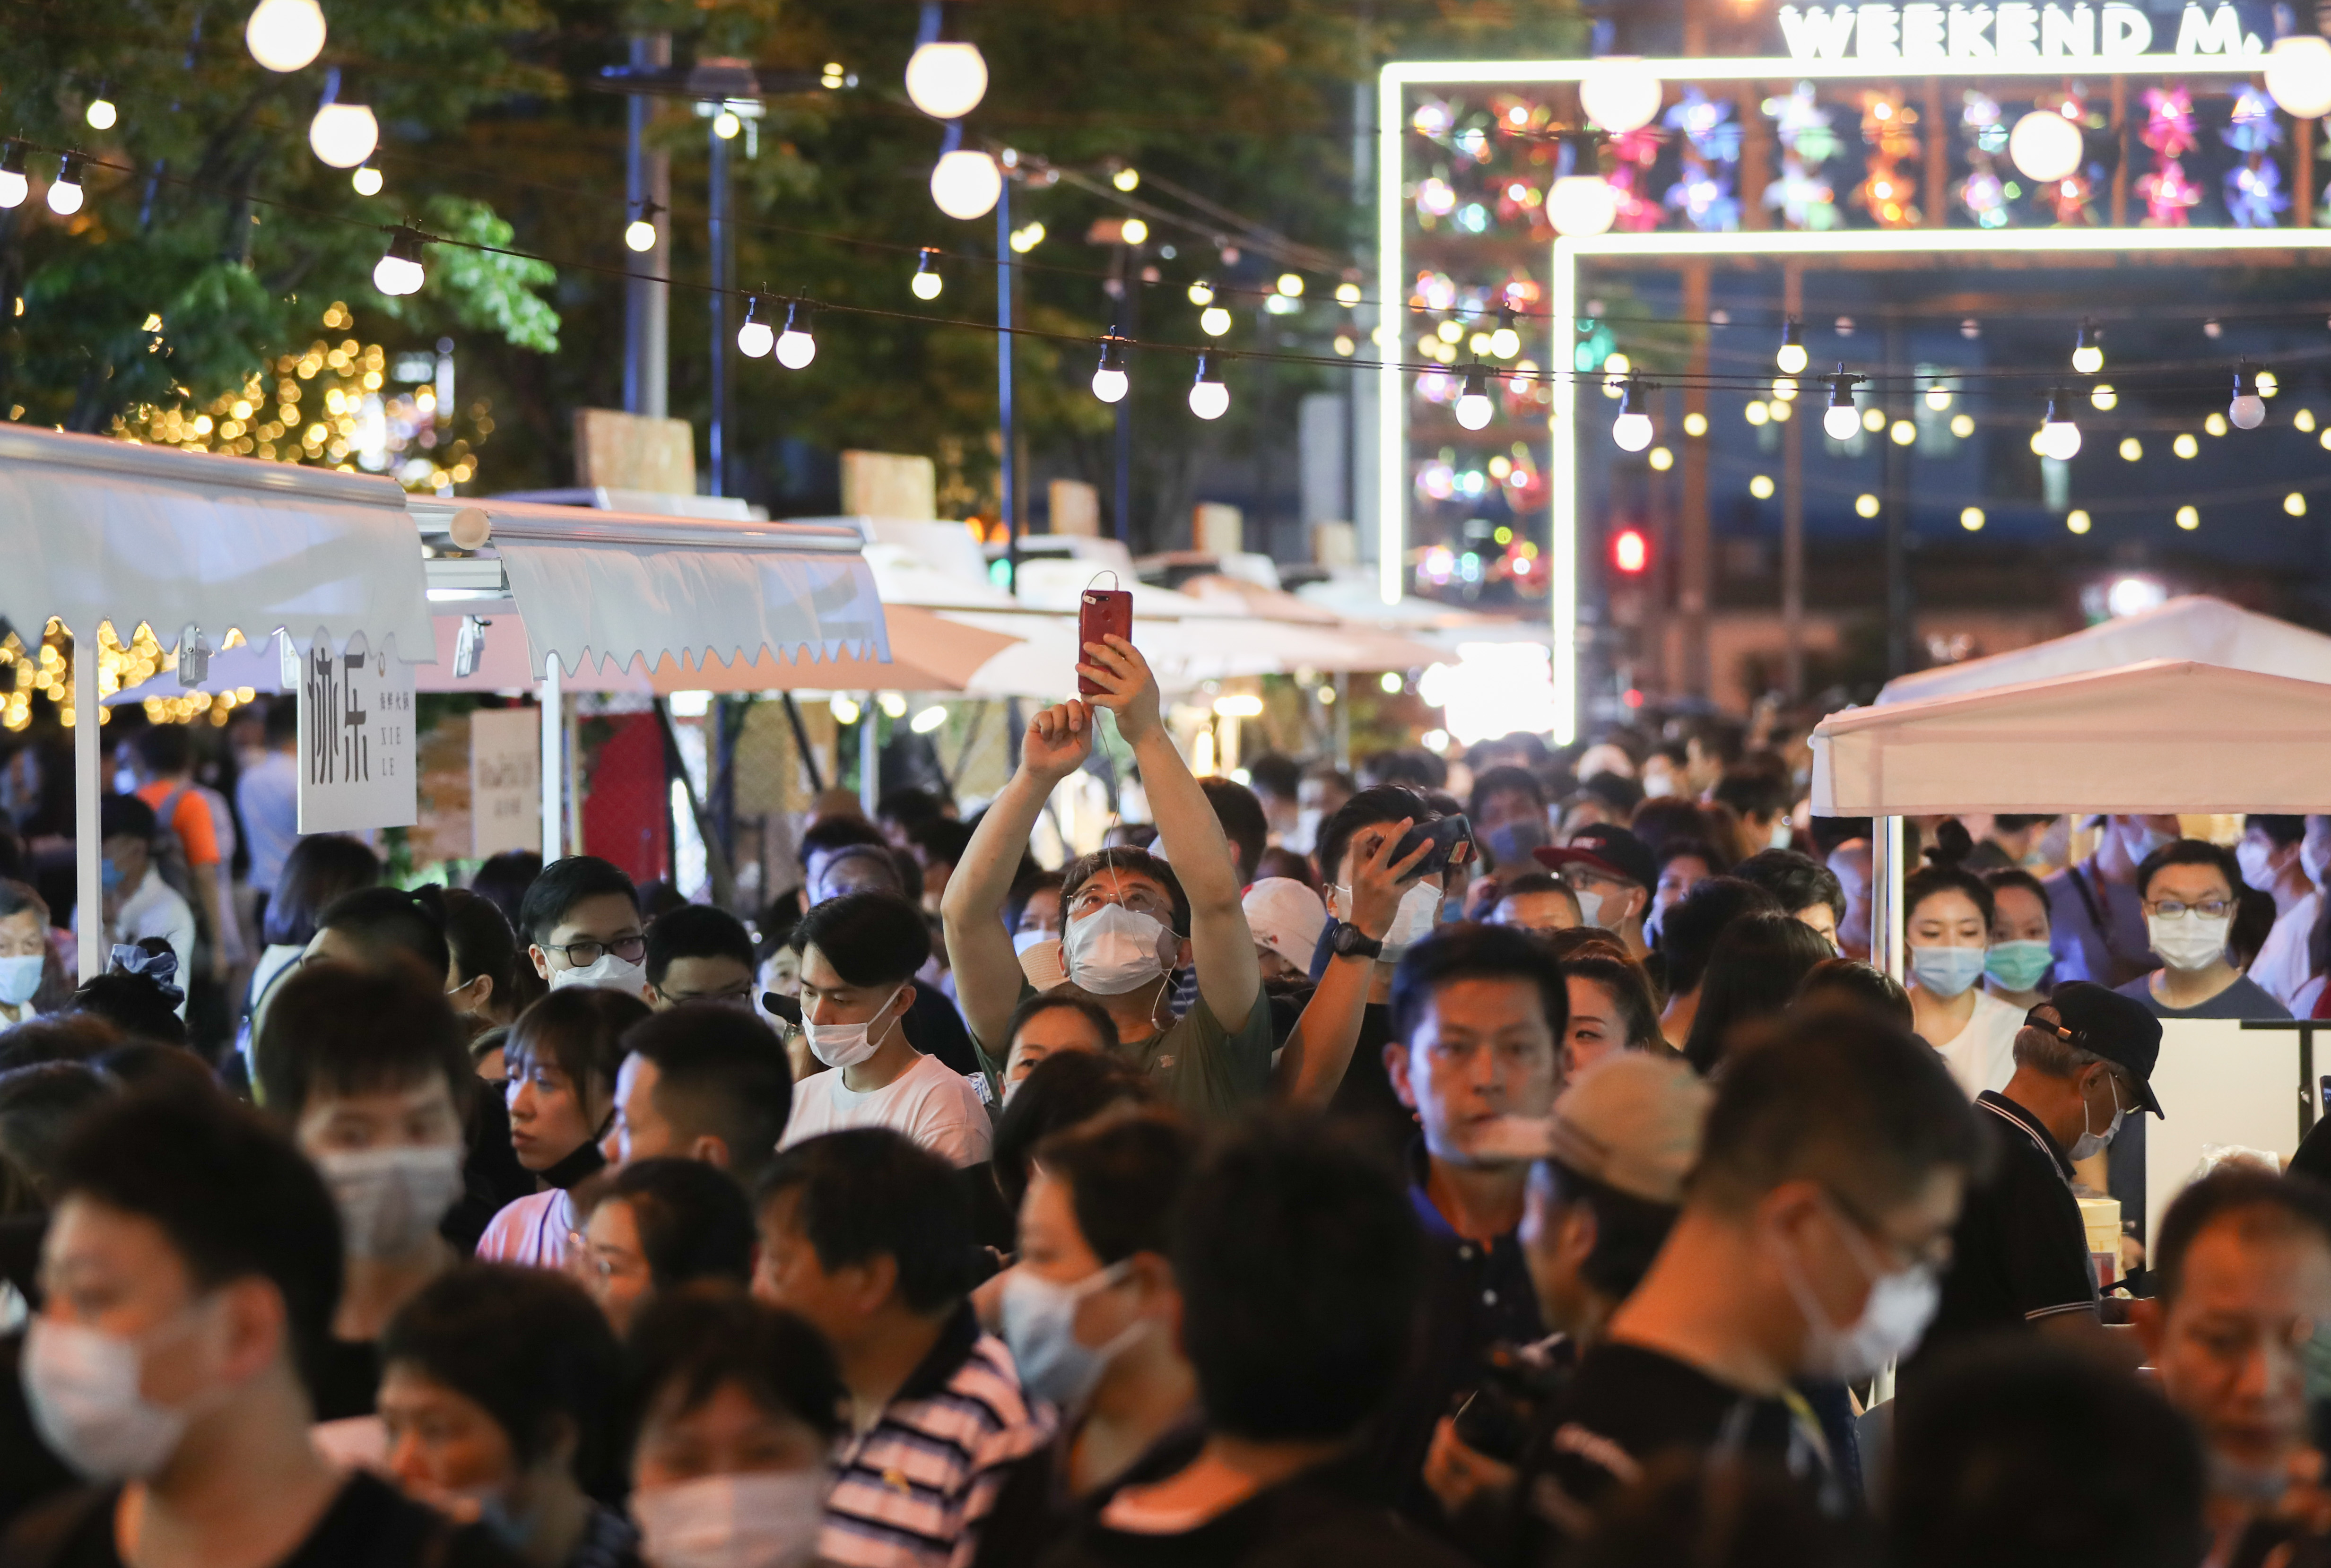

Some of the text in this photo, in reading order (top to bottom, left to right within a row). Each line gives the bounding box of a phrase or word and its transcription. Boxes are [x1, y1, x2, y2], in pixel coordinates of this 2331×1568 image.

[1778, 3, 2153, 58] WEEKEND
[381, 726, 401, 745] XIE
[382, 757, 394, 776] LE
